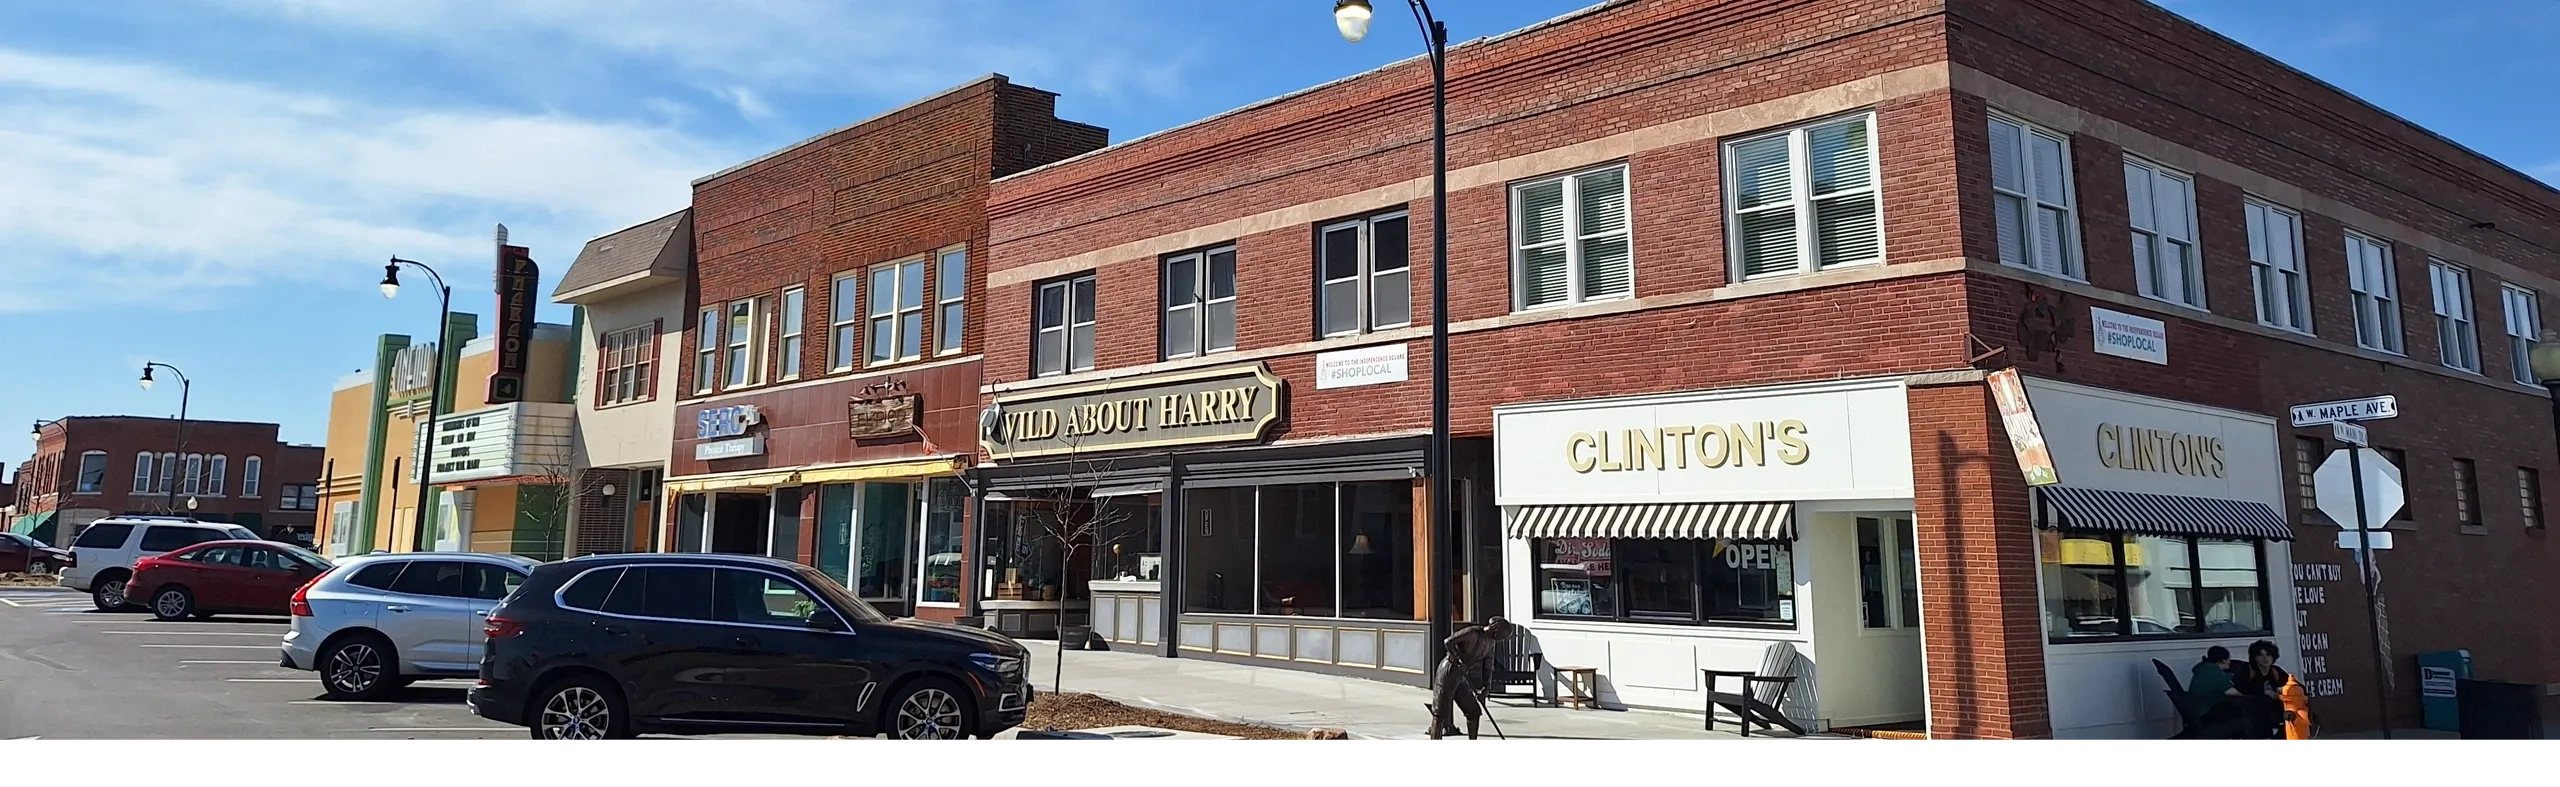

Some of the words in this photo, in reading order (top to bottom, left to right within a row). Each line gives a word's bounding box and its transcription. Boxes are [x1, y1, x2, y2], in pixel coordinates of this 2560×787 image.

[2107, 330, 2157, 352] #SHOPLOCAL
[1351, 358, 1359, 366] THE
[1359, 354, 1388, 364] INDEPENDENCE
[1331, 363, 1392, 379] #SHOPLOCAL
[1064, 397, 1153, 437] ABOUT
[1158, 385, 1259, 429] HARRY
[2306, 409, 2316, 418] W.
[2320, 404, 2359, 420] MAPLE
[2365, 401, 2391, 415] AVE.
[697, 405, 745, 438] SERC
[1566, 418, 1810, 473] CLINTON'S
[2097, 422, 2226, 479] CLINTON'S
[1726, 544, 1784, 569] OPEN
[2293, 564, 2304, 580] OU
[2306, 564, 2327, 580] CAN'T
[2328, 564, 2342, 581] BUY
[2304, 587, 2325, 603] LOVE
[2297, 610, 2307, 627] UT
[2301, 633, 2311, 650] OU
[2312, 633, 2329, 650] CAN
[2302, 656, 2312, 674] UY
[2315, 656, 2326, 673] ME
[2318, 679, 2344, 697] CREAM
